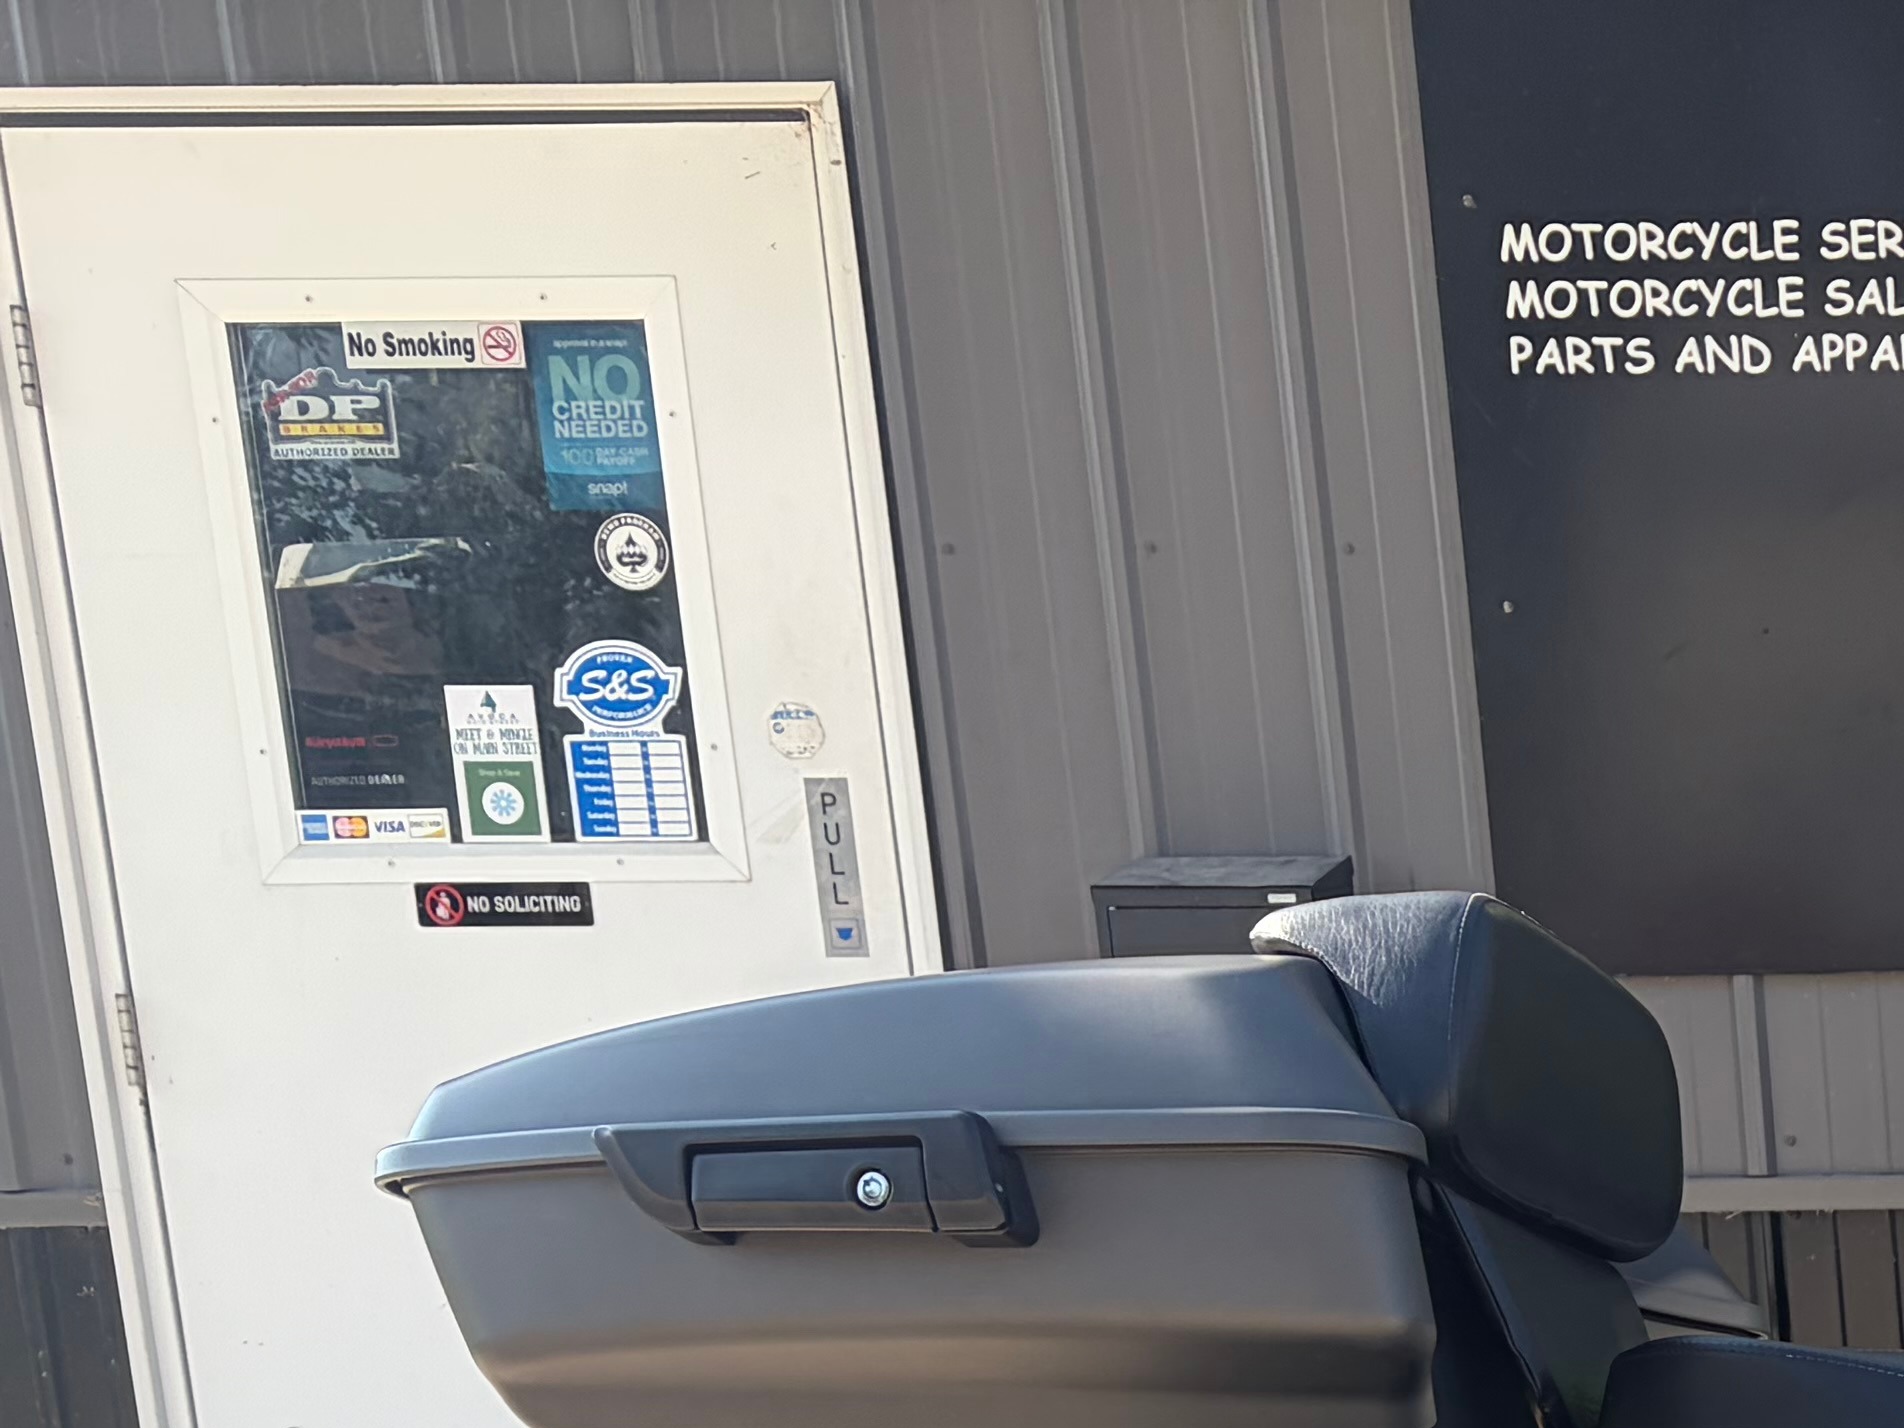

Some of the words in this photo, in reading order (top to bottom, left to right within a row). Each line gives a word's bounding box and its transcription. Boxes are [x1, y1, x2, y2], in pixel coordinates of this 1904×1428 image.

[1500, 218, 1800, 265] MOTORCYCLE
[1506, 275, 1805, 320] MOTORCYCLE
[347, 331, 377, 357] No
[382, 330, 476, 363] Smoking
[1509, 335, 1656, 375] PARTS
[1674, 333, 1772, 375] AND
[547, 353, 641, 402] NO
[278, 395, 381, 421] DP
[552, 400, 645, 420] CREDIT
[281, 425, 384, 435] BRAKES
[553, 420, 649, 439] NEEDED
[273, 447, 349, 458] AUTHORIZED
[352, 447, 397, 457] DEALER
[577, 668, 656, 702] S&S
[502, 742, 539, 756] STREET
[374, 820, 406, 833] VISA
[819, 791, 850, 906] PULL
[466, 895, 490, 913] NO
[494, 895, 582, 913] SOLICITING
